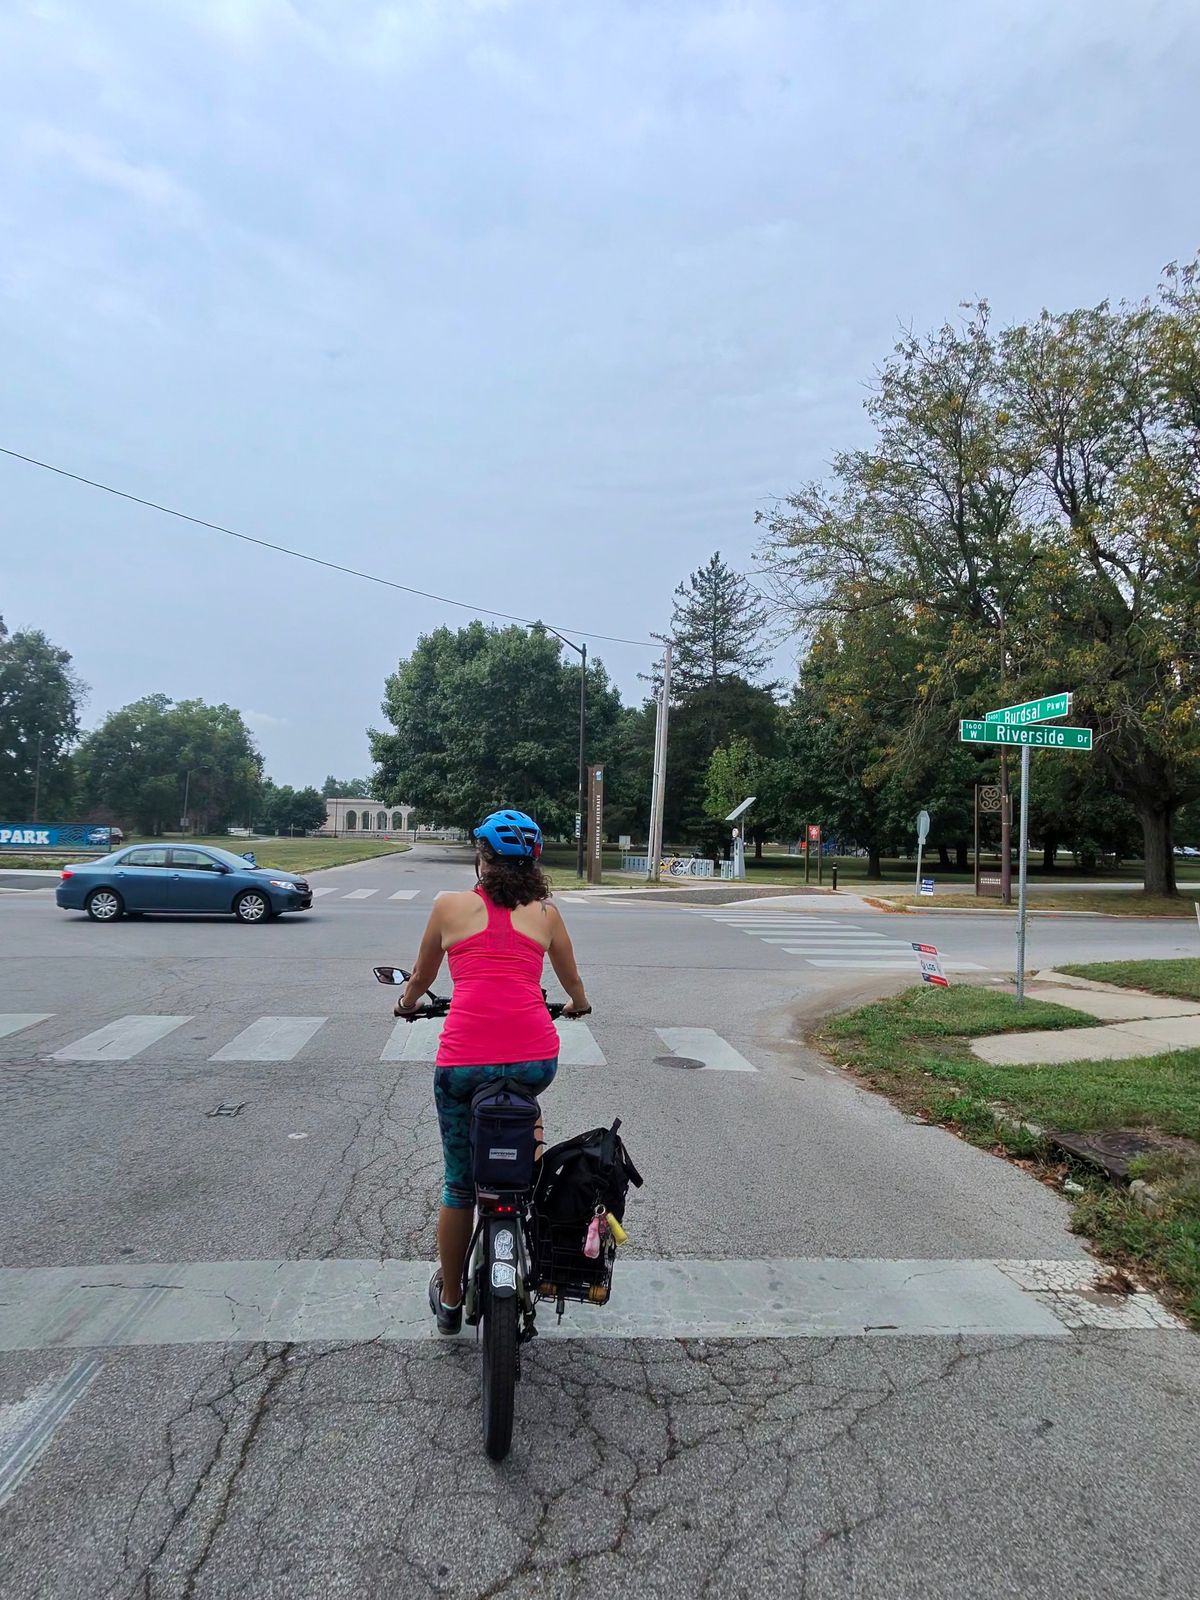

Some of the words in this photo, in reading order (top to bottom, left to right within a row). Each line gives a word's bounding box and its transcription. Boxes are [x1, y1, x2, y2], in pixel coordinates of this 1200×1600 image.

[1004, 703, 1040, 724] Burdsal
[970, 730, 977, 739] W
[996, 725, 1065, 745] Riverside
[1077, 734, 1088, 743] Dr
[0, 830, 49, 844] PARK
